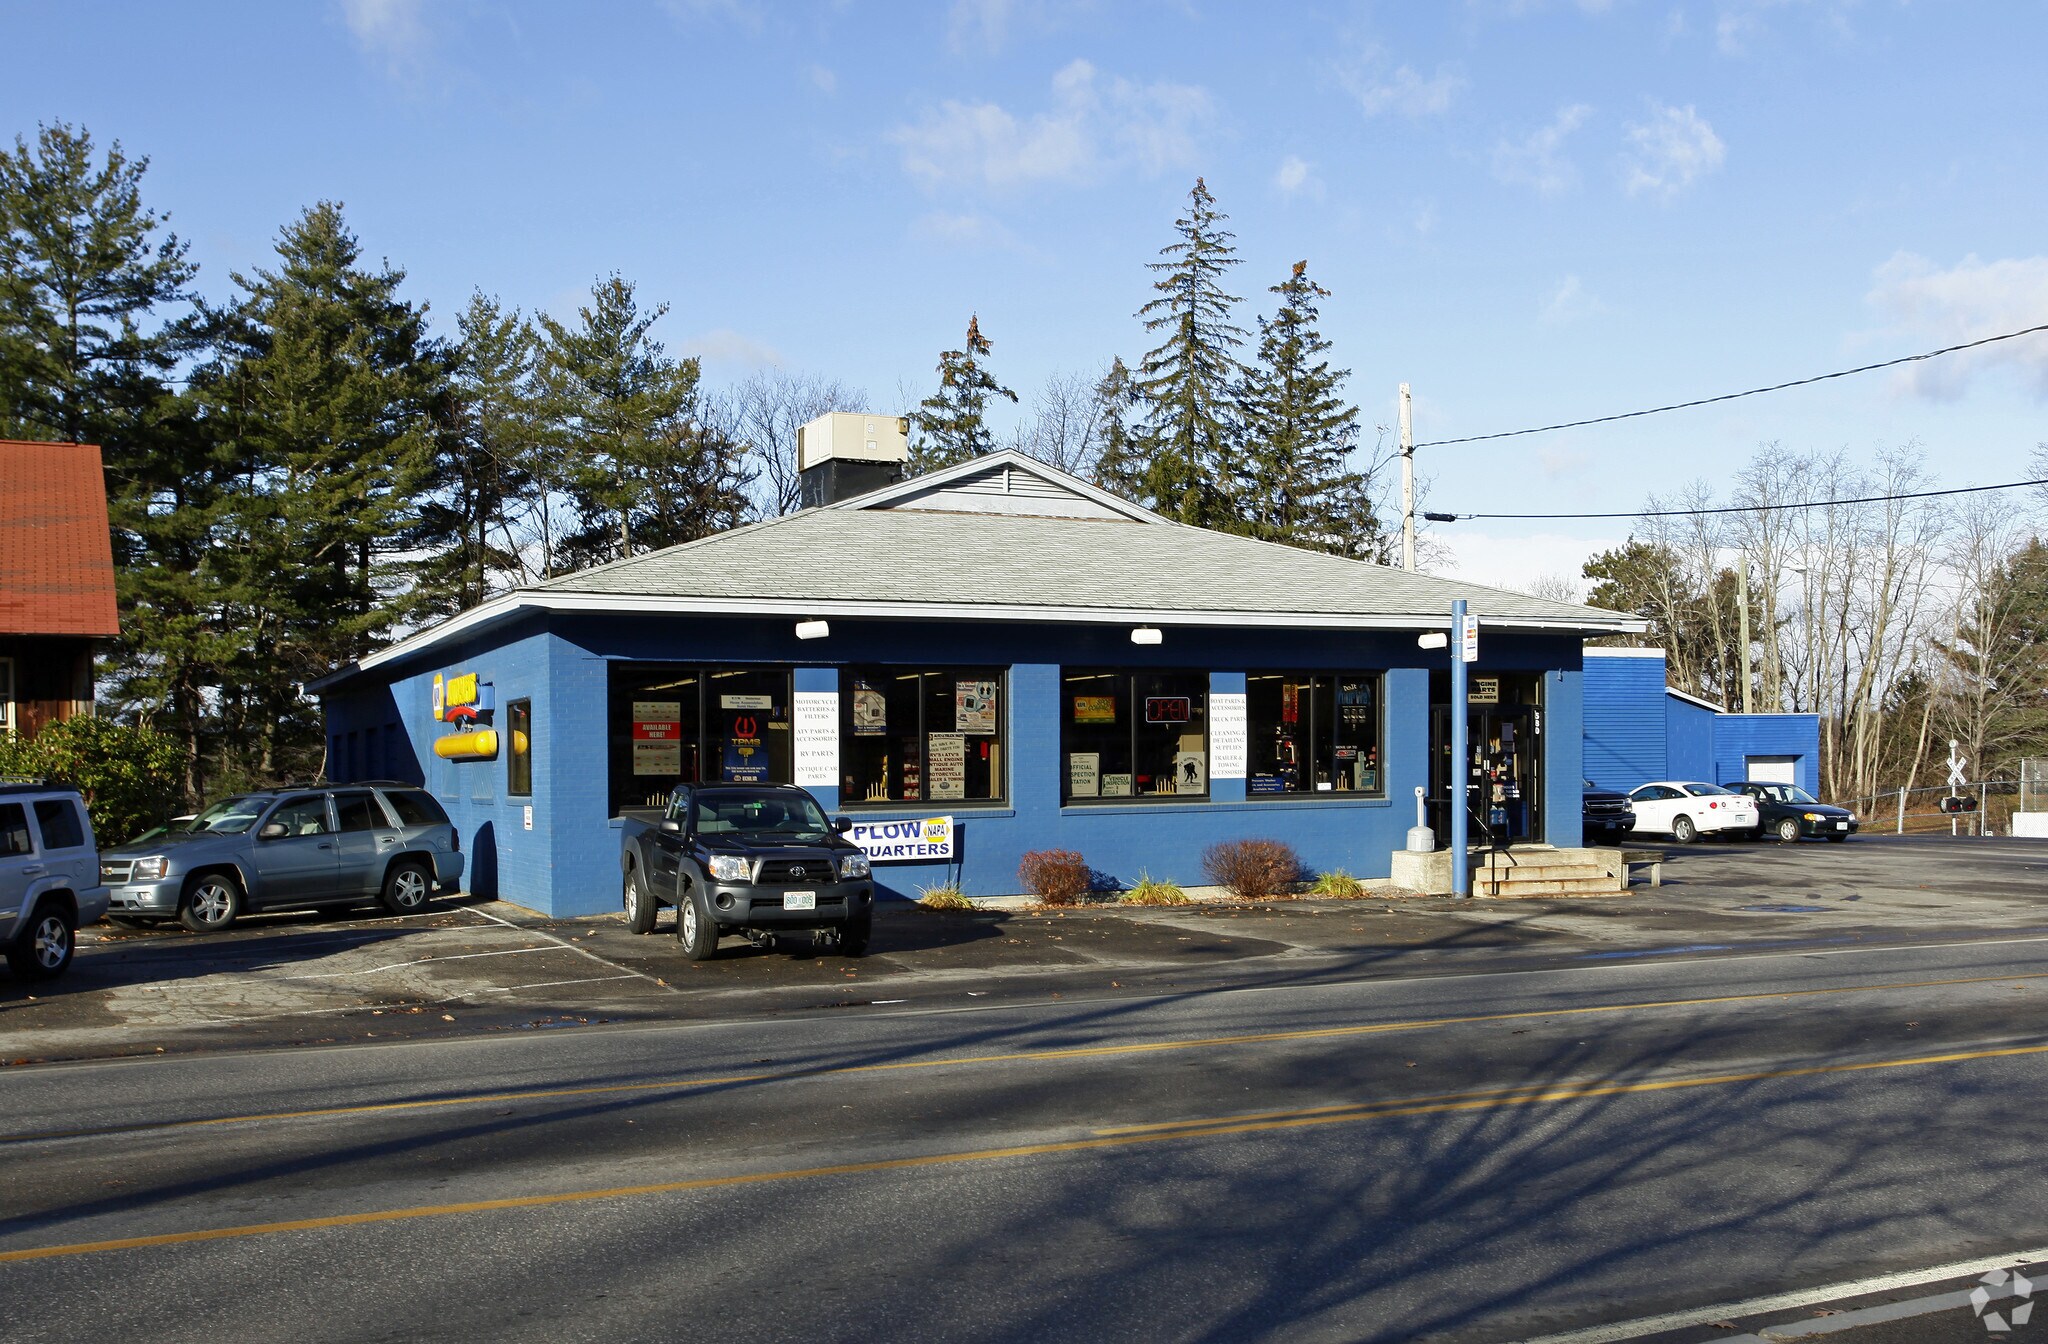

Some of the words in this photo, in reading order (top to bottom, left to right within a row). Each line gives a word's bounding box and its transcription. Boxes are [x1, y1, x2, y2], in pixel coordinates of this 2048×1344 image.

[1148, 700, 1188, 720] OPEN
[854, 821, 921, 840] PLOW
[927, 825, 945, 836] NAPA
[860, 843, 950, 857] QUARTERS
